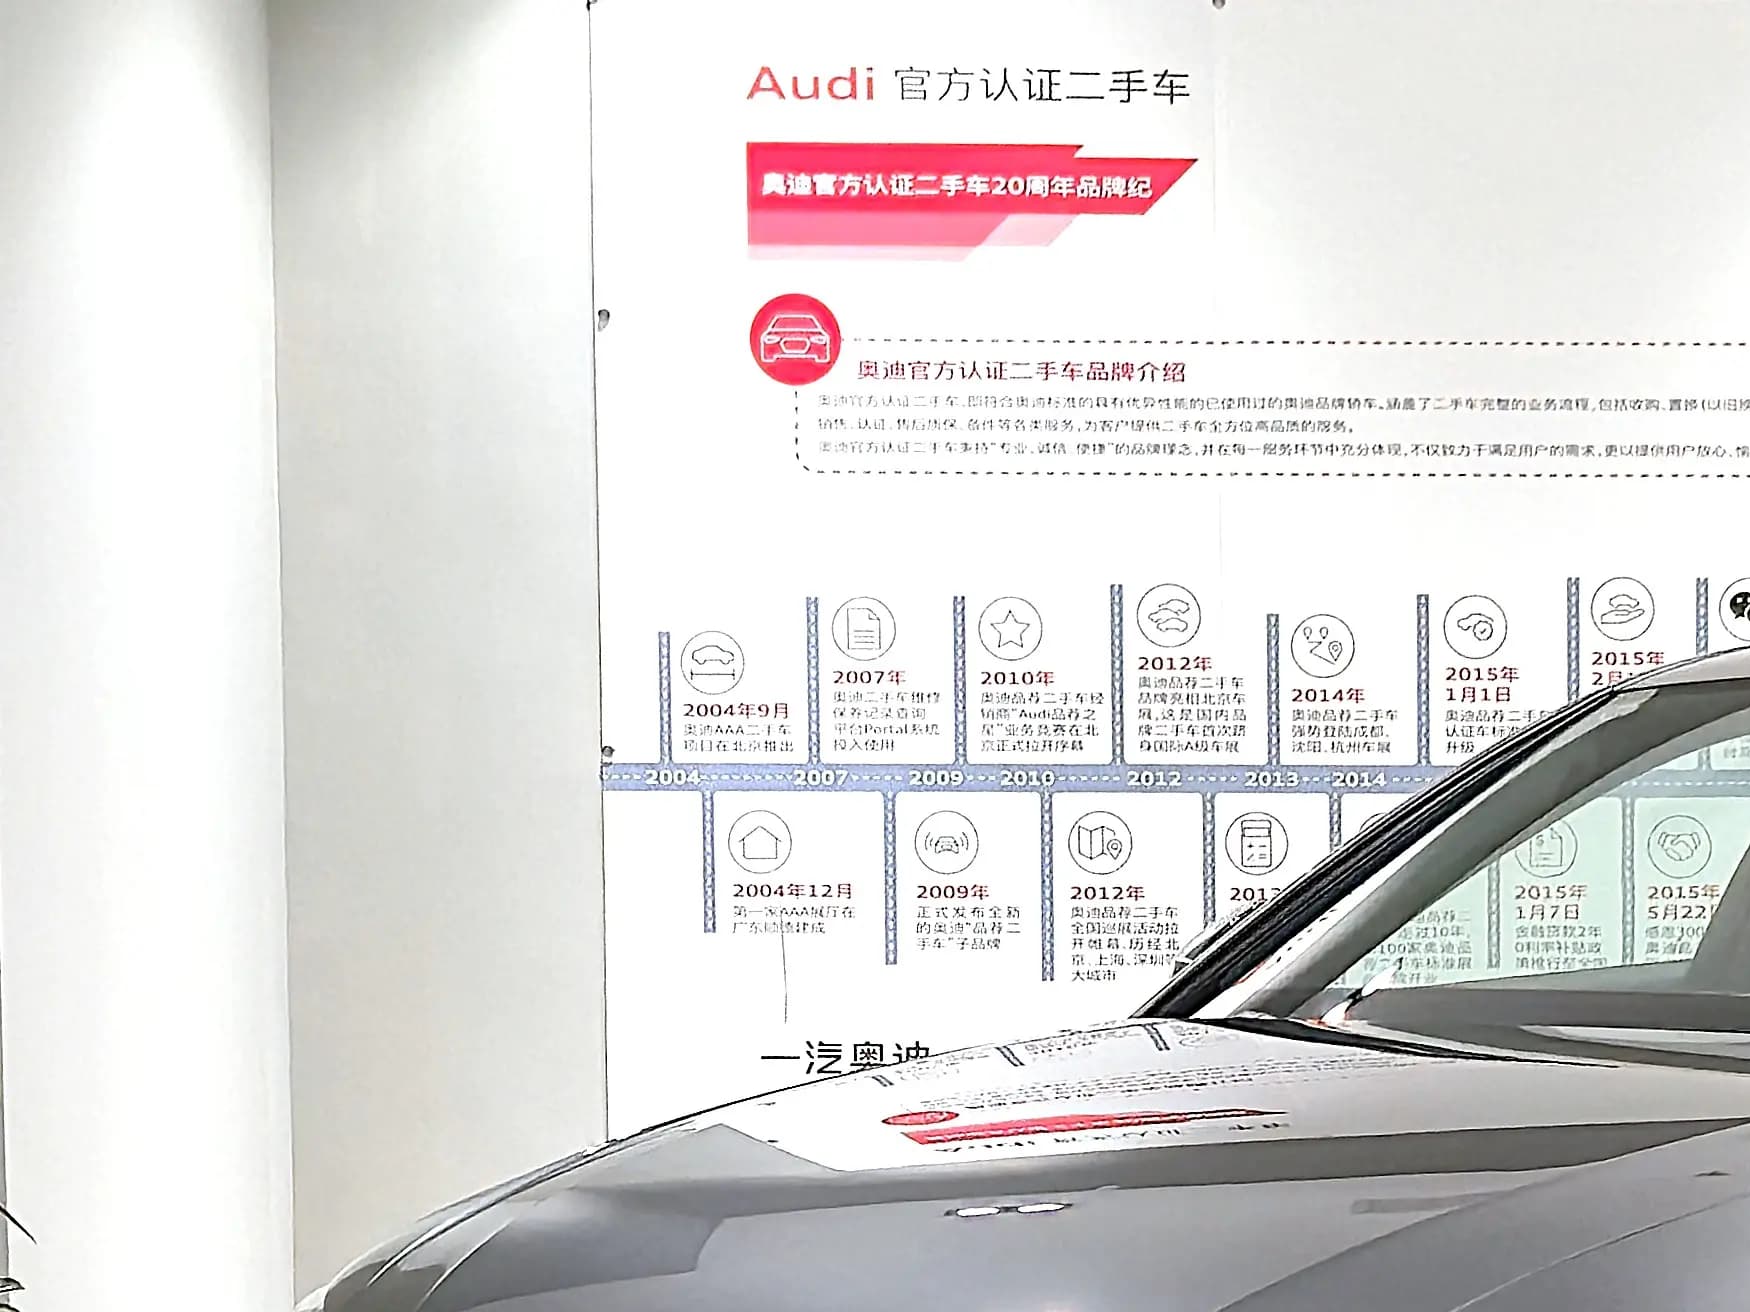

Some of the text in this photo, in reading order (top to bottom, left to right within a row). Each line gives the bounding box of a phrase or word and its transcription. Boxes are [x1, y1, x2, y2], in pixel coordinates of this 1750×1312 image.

[746, 66, 1191, 104] Audi 官方认证二手车
[761, 173, 1153, 200] 奥迪官方认证二手车20周年品牌纪
[857, 360, 1187, 383] 奥迪官方认证二手车品牌介绍
[1138, 656, 1212, 671] 2012年
[1592, 652, 1664, 666] 2015年
[833, 670, 905, 685] 2007年
[980, 671, 1054, 686] 2010年
[1445, 666, 1521, 683] 2015年
[1592, 671, 1633, 686] 2月
[1292, 688, 1365, 703] 2014年
[1446, 687, 1511, 703] 1月1日
[683, 703, 789, 718] 2004年9月
[645, 769, 700, 786] 2004
[793, 769, 849, 786] 2007
[908, 769, 965, 786] 2009
[1000, 770, 1055, 786] 2010
[1127, 771, 1182, 787] 2012
[1244, 772, 1299, 788] 2013
[1332, 772, 1388, 788] 2014
[732, 883, 852, 900] 2004年12月
[917, 884, 989, 900] 2009年
[1070, 885, 1145, 901] 2012年
[1515, 885, 1587, 900] 2015年
[1648, 885, 1720, 899] 2015年
[1516, 904, 1579, 920] 1月7日
